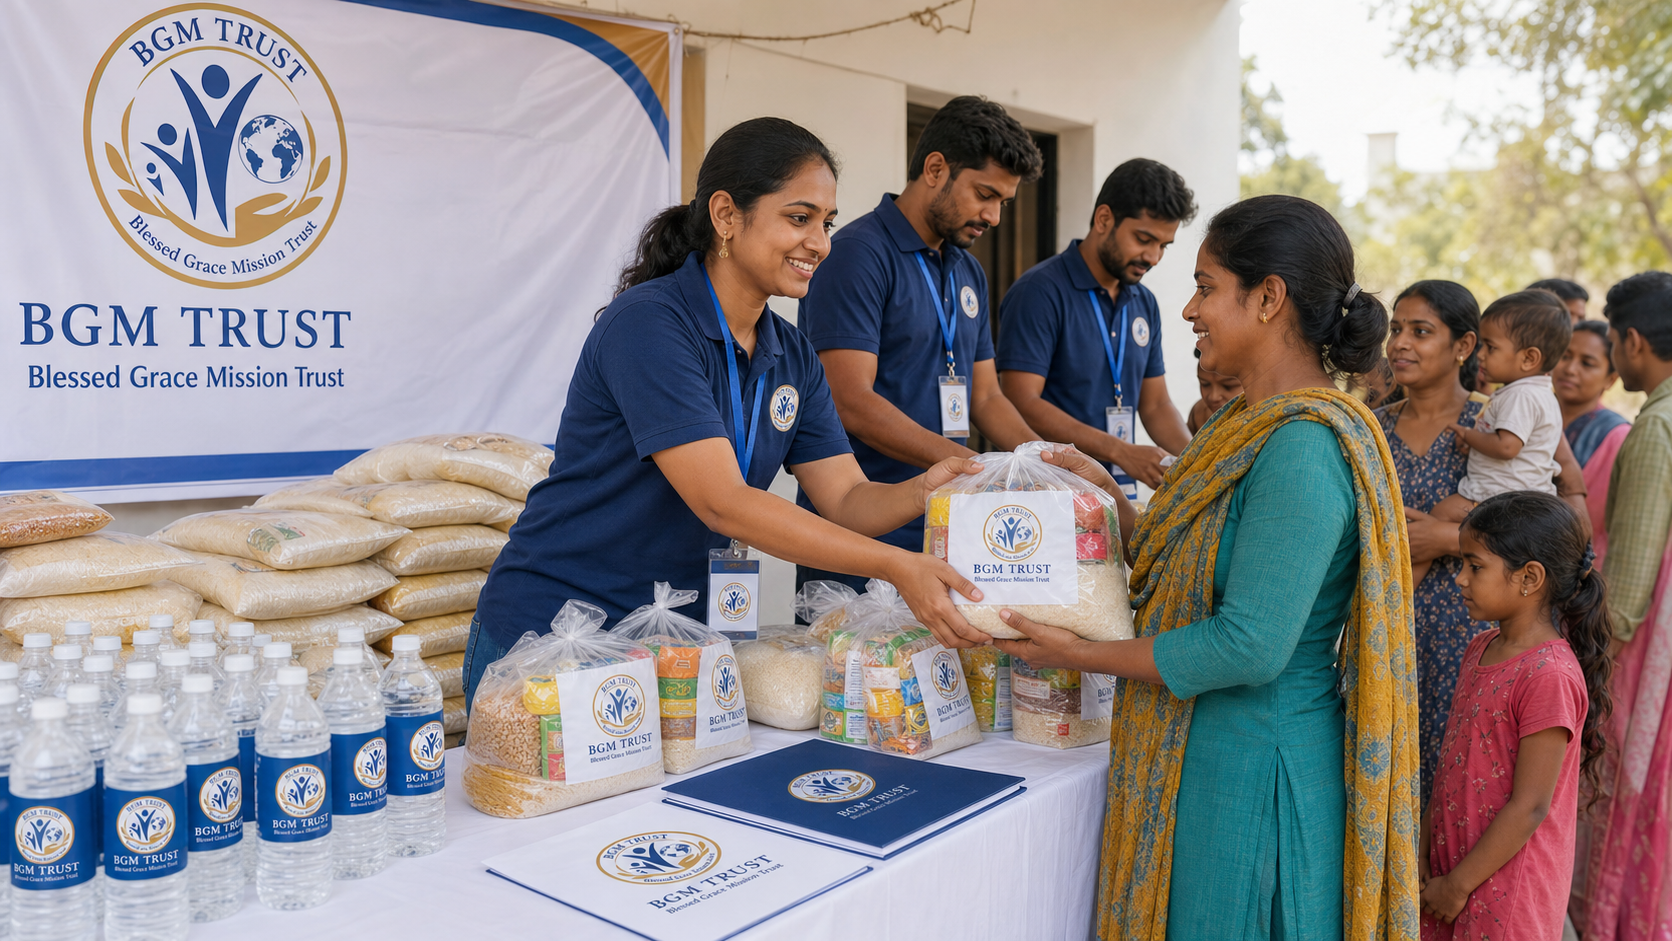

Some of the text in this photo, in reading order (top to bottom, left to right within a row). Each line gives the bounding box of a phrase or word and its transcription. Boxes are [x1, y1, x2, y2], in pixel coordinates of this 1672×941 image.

[129, 17, 307, 83] BGM TRUST
[128, 214, 318, 275] Blessed Grace Mission Trust
[19, 302, 351, 349] BGM TRUST
[28, 364, 345, 388] Blessed Grace Mission Trust
[973, 563, 1051, 574] BGM TRUST
[588, 732, 652, 755] BGM TRUST
[405, 772, 429, 783] BGM
[349, 790, 372, 802] BGM
[836, 802, 870, 817] BGM
[867, 784, 910, 803] TRUST
[272, 819, 297, 829] BGM
[301, 812, 329, 828] TRUST
[194, 825, 220, 837] BGM
[113, 855, 139, 866] BGM
[142, 849, 179, 865] TRUST
[14, 861, 80, 876] BGM TRUST
[647, 885, 702, 910] BGM
[700, 854, 772, 887] TRUST
